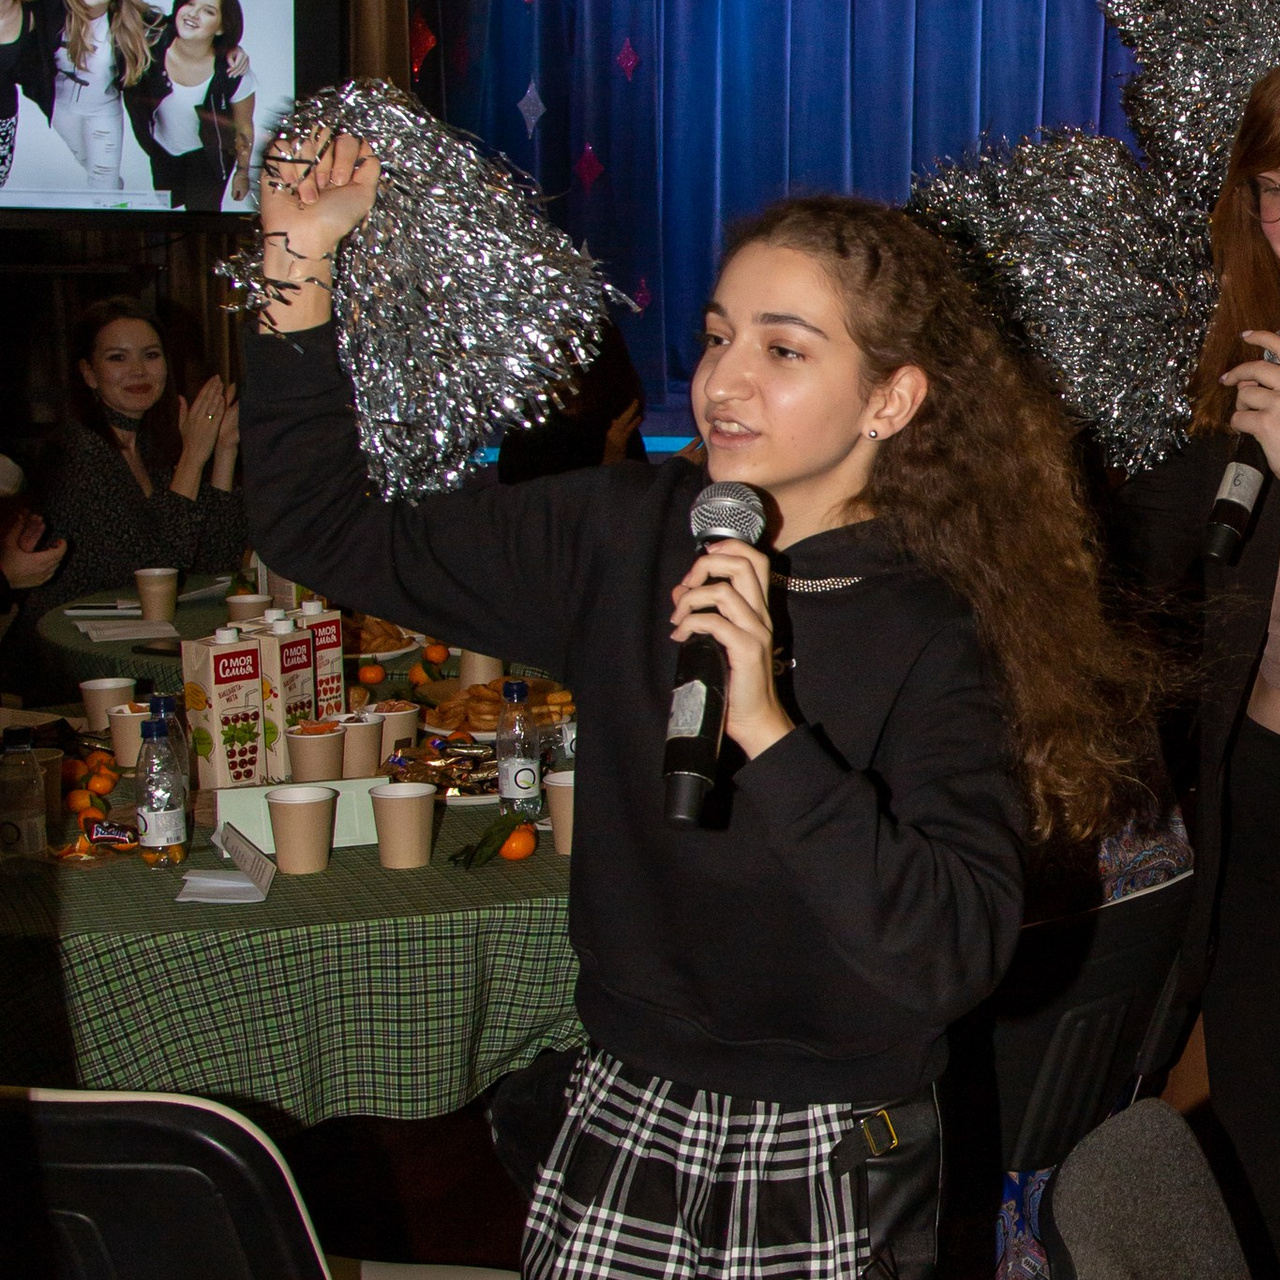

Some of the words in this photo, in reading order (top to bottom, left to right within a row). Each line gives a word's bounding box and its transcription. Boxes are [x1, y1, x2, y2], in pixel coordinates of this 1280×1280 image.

[1233, 473, 1244, 487] 6
[219, 658, 254, 678] Семья
[230, 655, 252, 667] МОЯ
